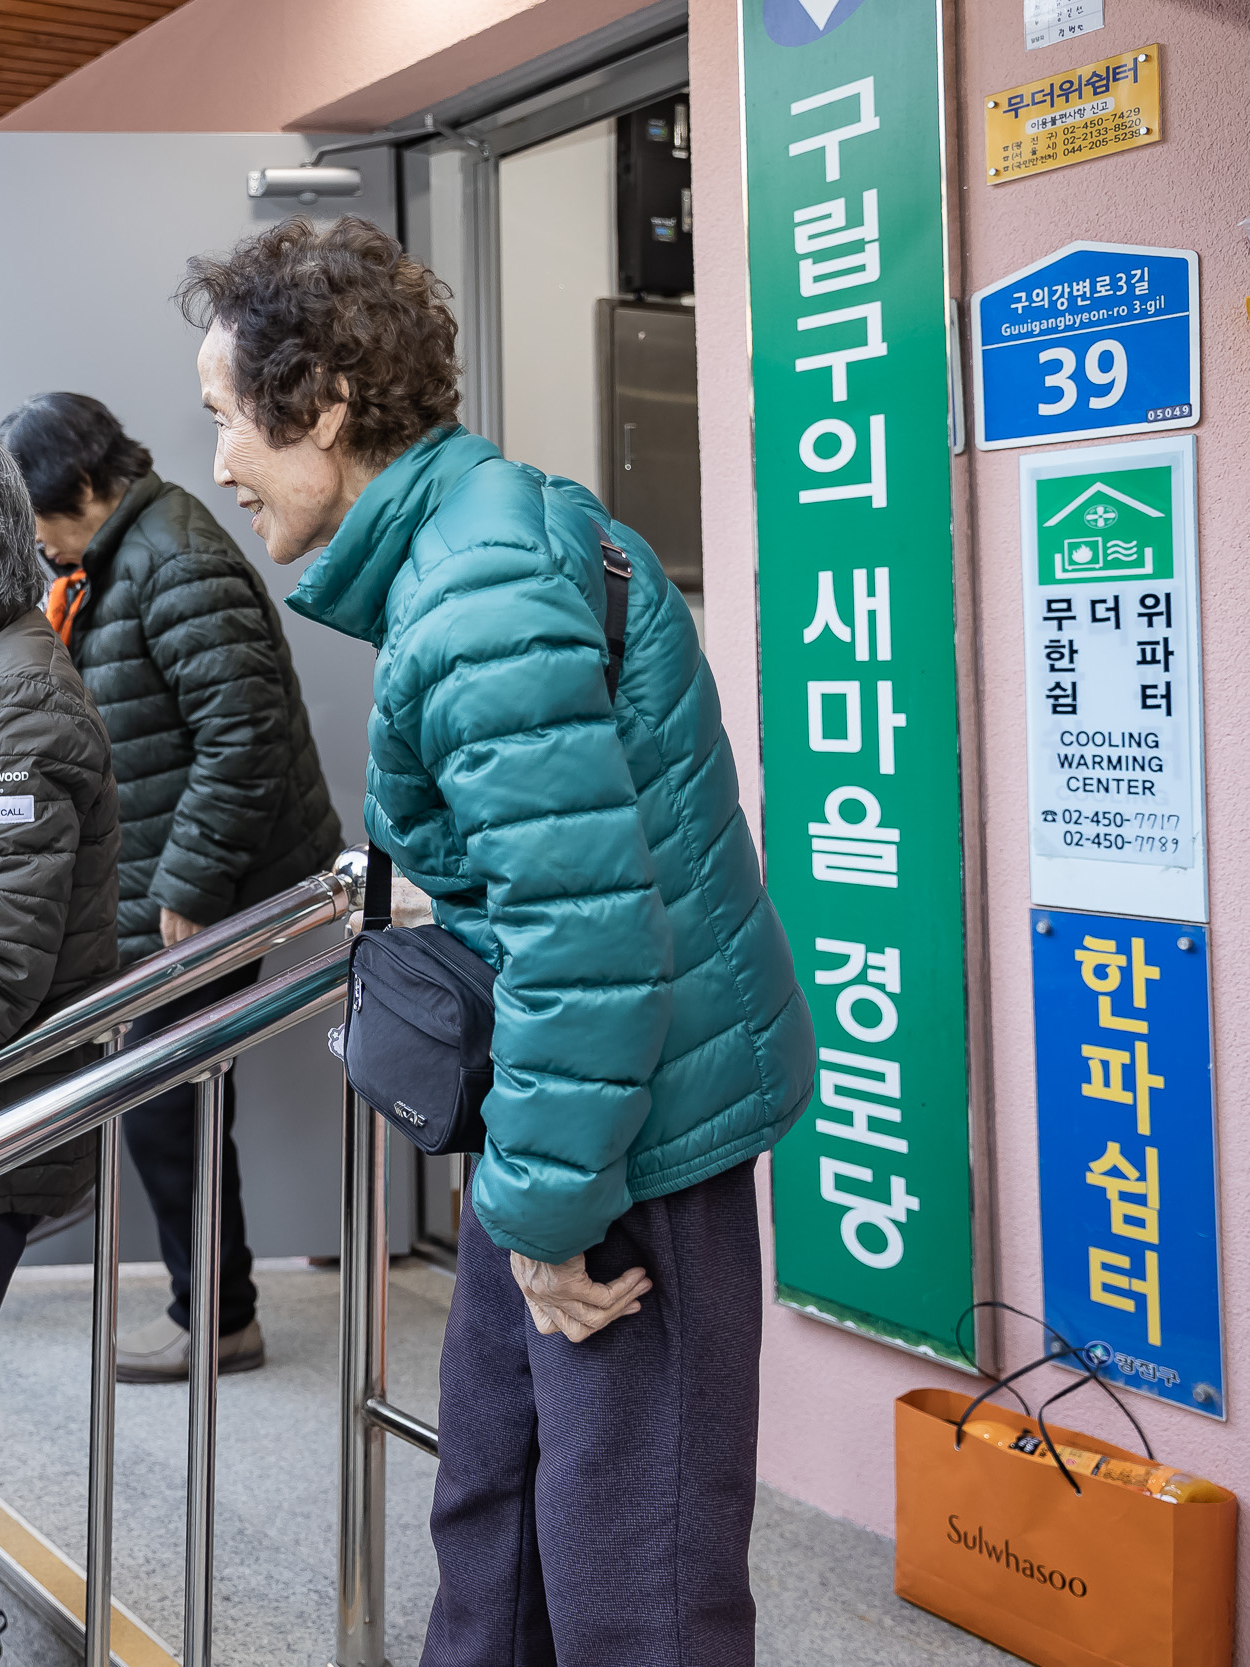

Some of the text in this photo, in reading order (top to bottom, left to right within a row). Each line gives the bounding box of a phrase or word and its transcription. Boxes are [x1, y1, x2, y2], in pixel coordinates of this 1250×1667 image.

[1003, 57, 1139, 119] 무더위쉼터
[1030, 100, 1110, 131] 이용불편사항 신고
[1062, 106, 1141, 136] 02-450-7429
[1062, 117, 1142, 147] 02-2133-8520
[1010, 266, 1150, 315] 구의강변로3길
[1001, 295, 1166, 337] Guuigangbyeon-ro 3-gil
[1037, 338, 1129, 416] 39
[1147, 405, 1190, 421] 05049
[1060, 730, 1161, 750] COOLING
[1057, 752, 1164, 773] WARMING
[1066, 776, 1156, 797] CENTER
[814, 936, 920, 1270] 경로당
[1114, 1351, 1181, 1388] 광진구
[946, 1513, 1088, 1599] Sulwhasoo
